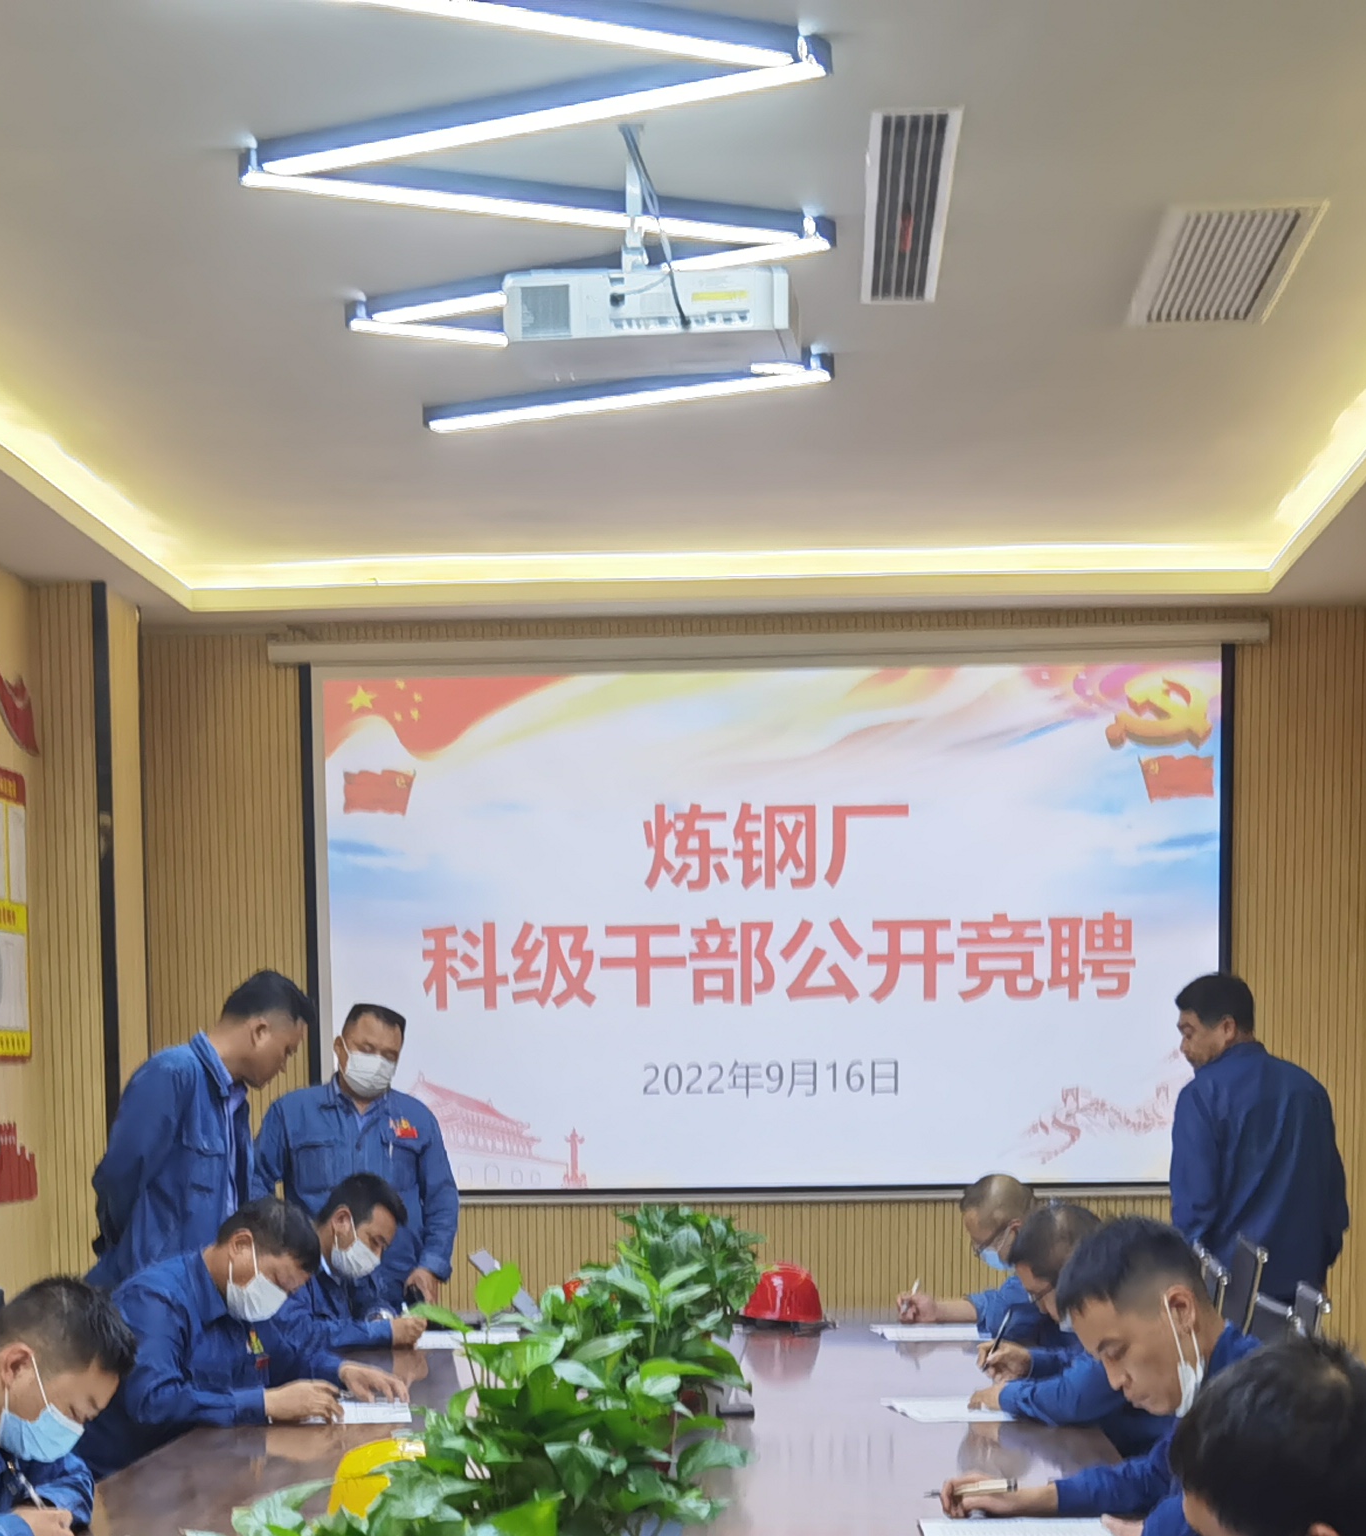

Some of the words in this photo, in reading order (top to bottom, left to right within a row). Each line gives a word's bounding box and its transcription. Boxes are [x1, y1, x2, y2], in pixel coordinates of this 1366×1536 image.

[643, 802, 910, 891] 炼钢厂
[422, 911, 1136, 1010] 科级干部公开竞聘
[642, 1058, 900, 1099] 2022年9月16日
